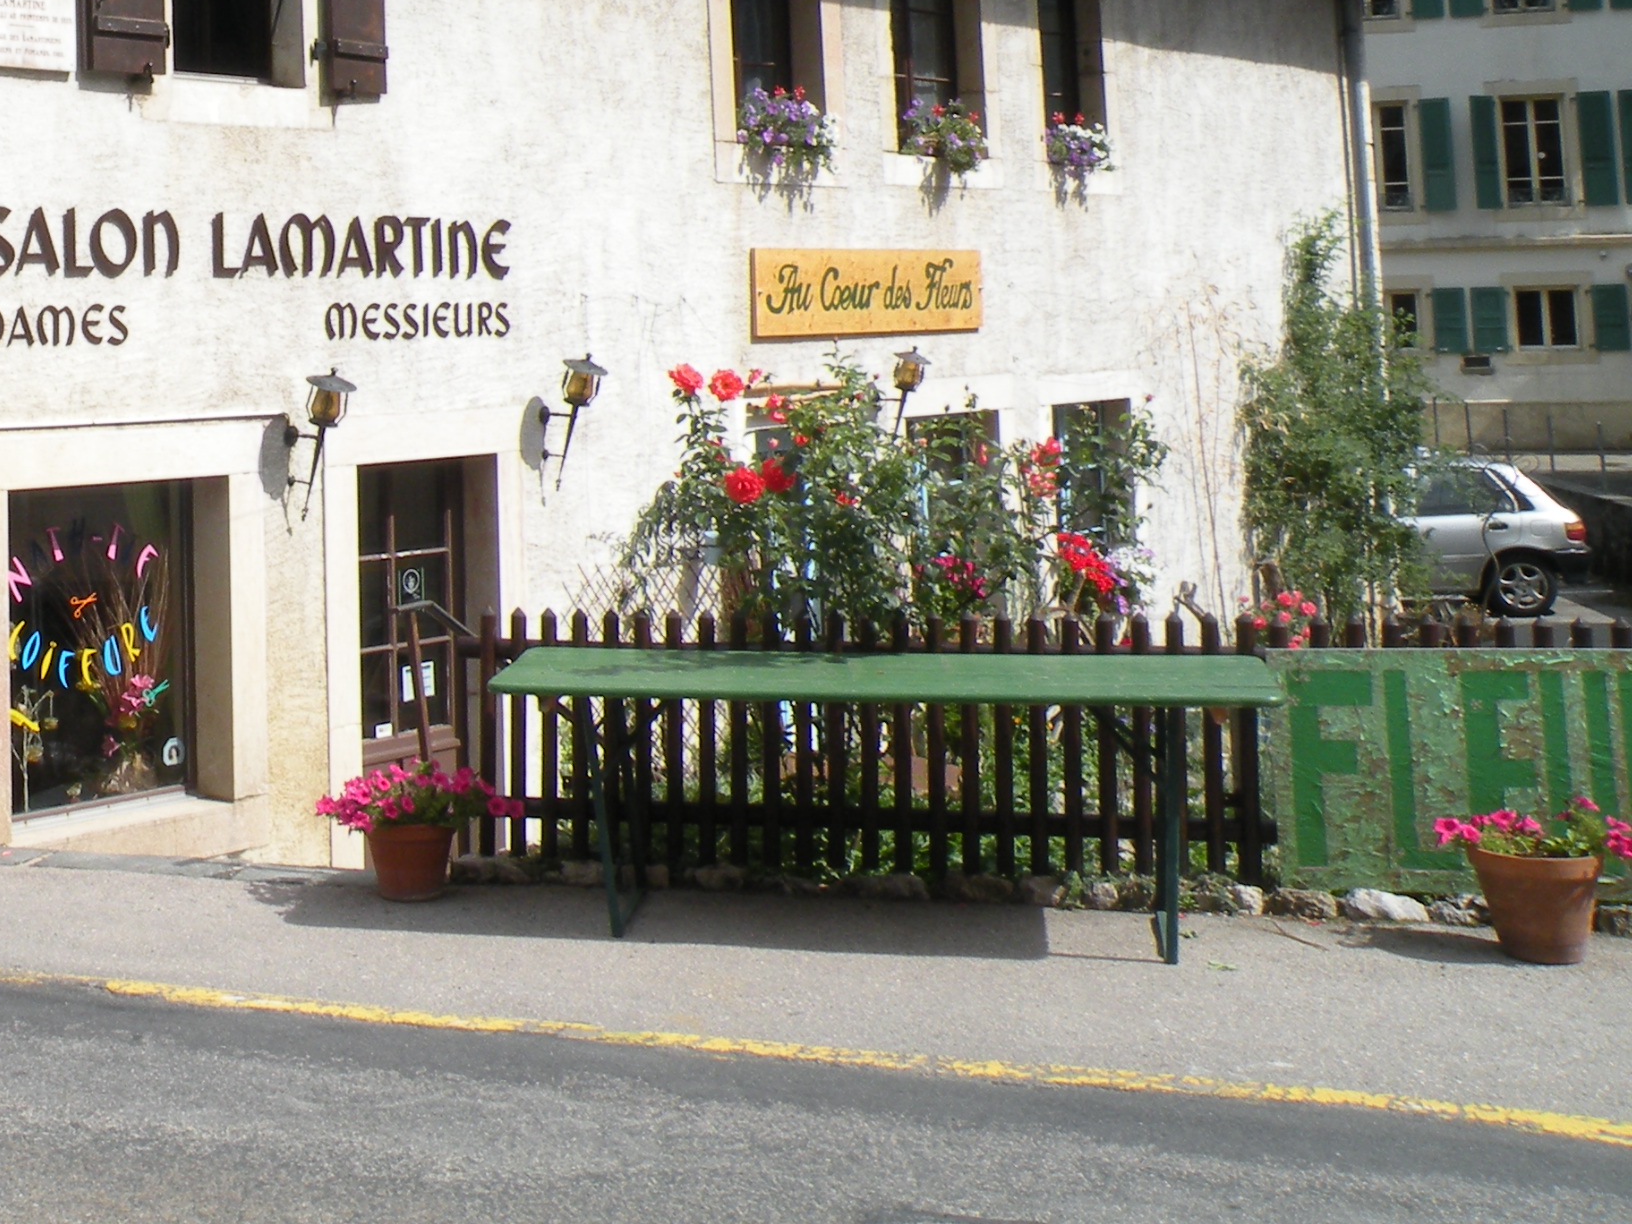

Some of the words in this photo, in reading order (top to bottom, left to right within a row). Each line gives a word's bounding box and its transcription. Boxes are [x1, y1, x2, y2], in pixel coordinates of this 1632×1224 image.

[211, 211, 512, 281] LAMARTINE
[766, 264, 813, 314] Au
[883, 264, 912, 310] des
[915, 258, 973, 311] Fleurs
[324, 301, 511, 341] MESSIEURS
